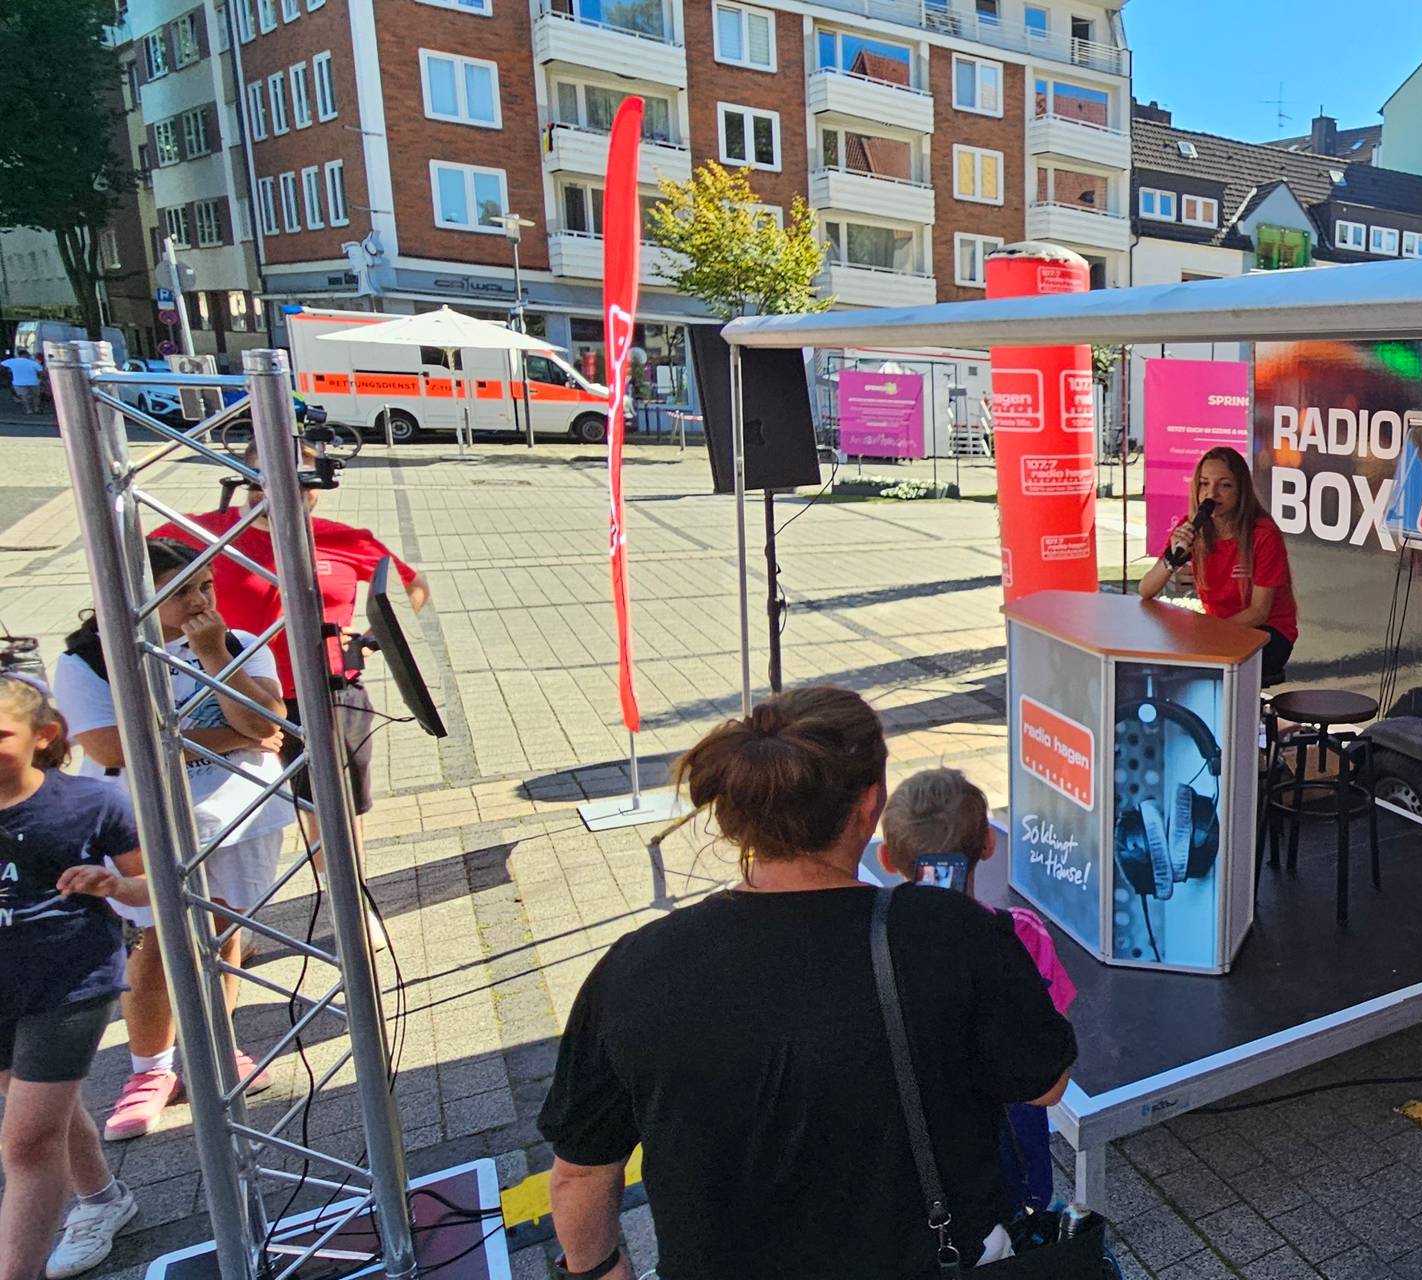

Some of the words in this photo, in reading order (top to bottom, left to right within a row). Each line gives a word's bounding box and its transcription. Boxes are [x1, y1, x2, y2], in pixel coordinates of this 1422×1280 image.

[328, 379, 416, 390] RETTUNGSDIENST
[992, 393, 1032, 407] agen
[1273, 405, 1402, 460] RADIO
[1271, 465, 1398, 552] BOX
[1023, 721, 1052, 748] radio
[1053, 734, 1090, 770] hagen
[1044, 850, 1092, 891] Hause!
